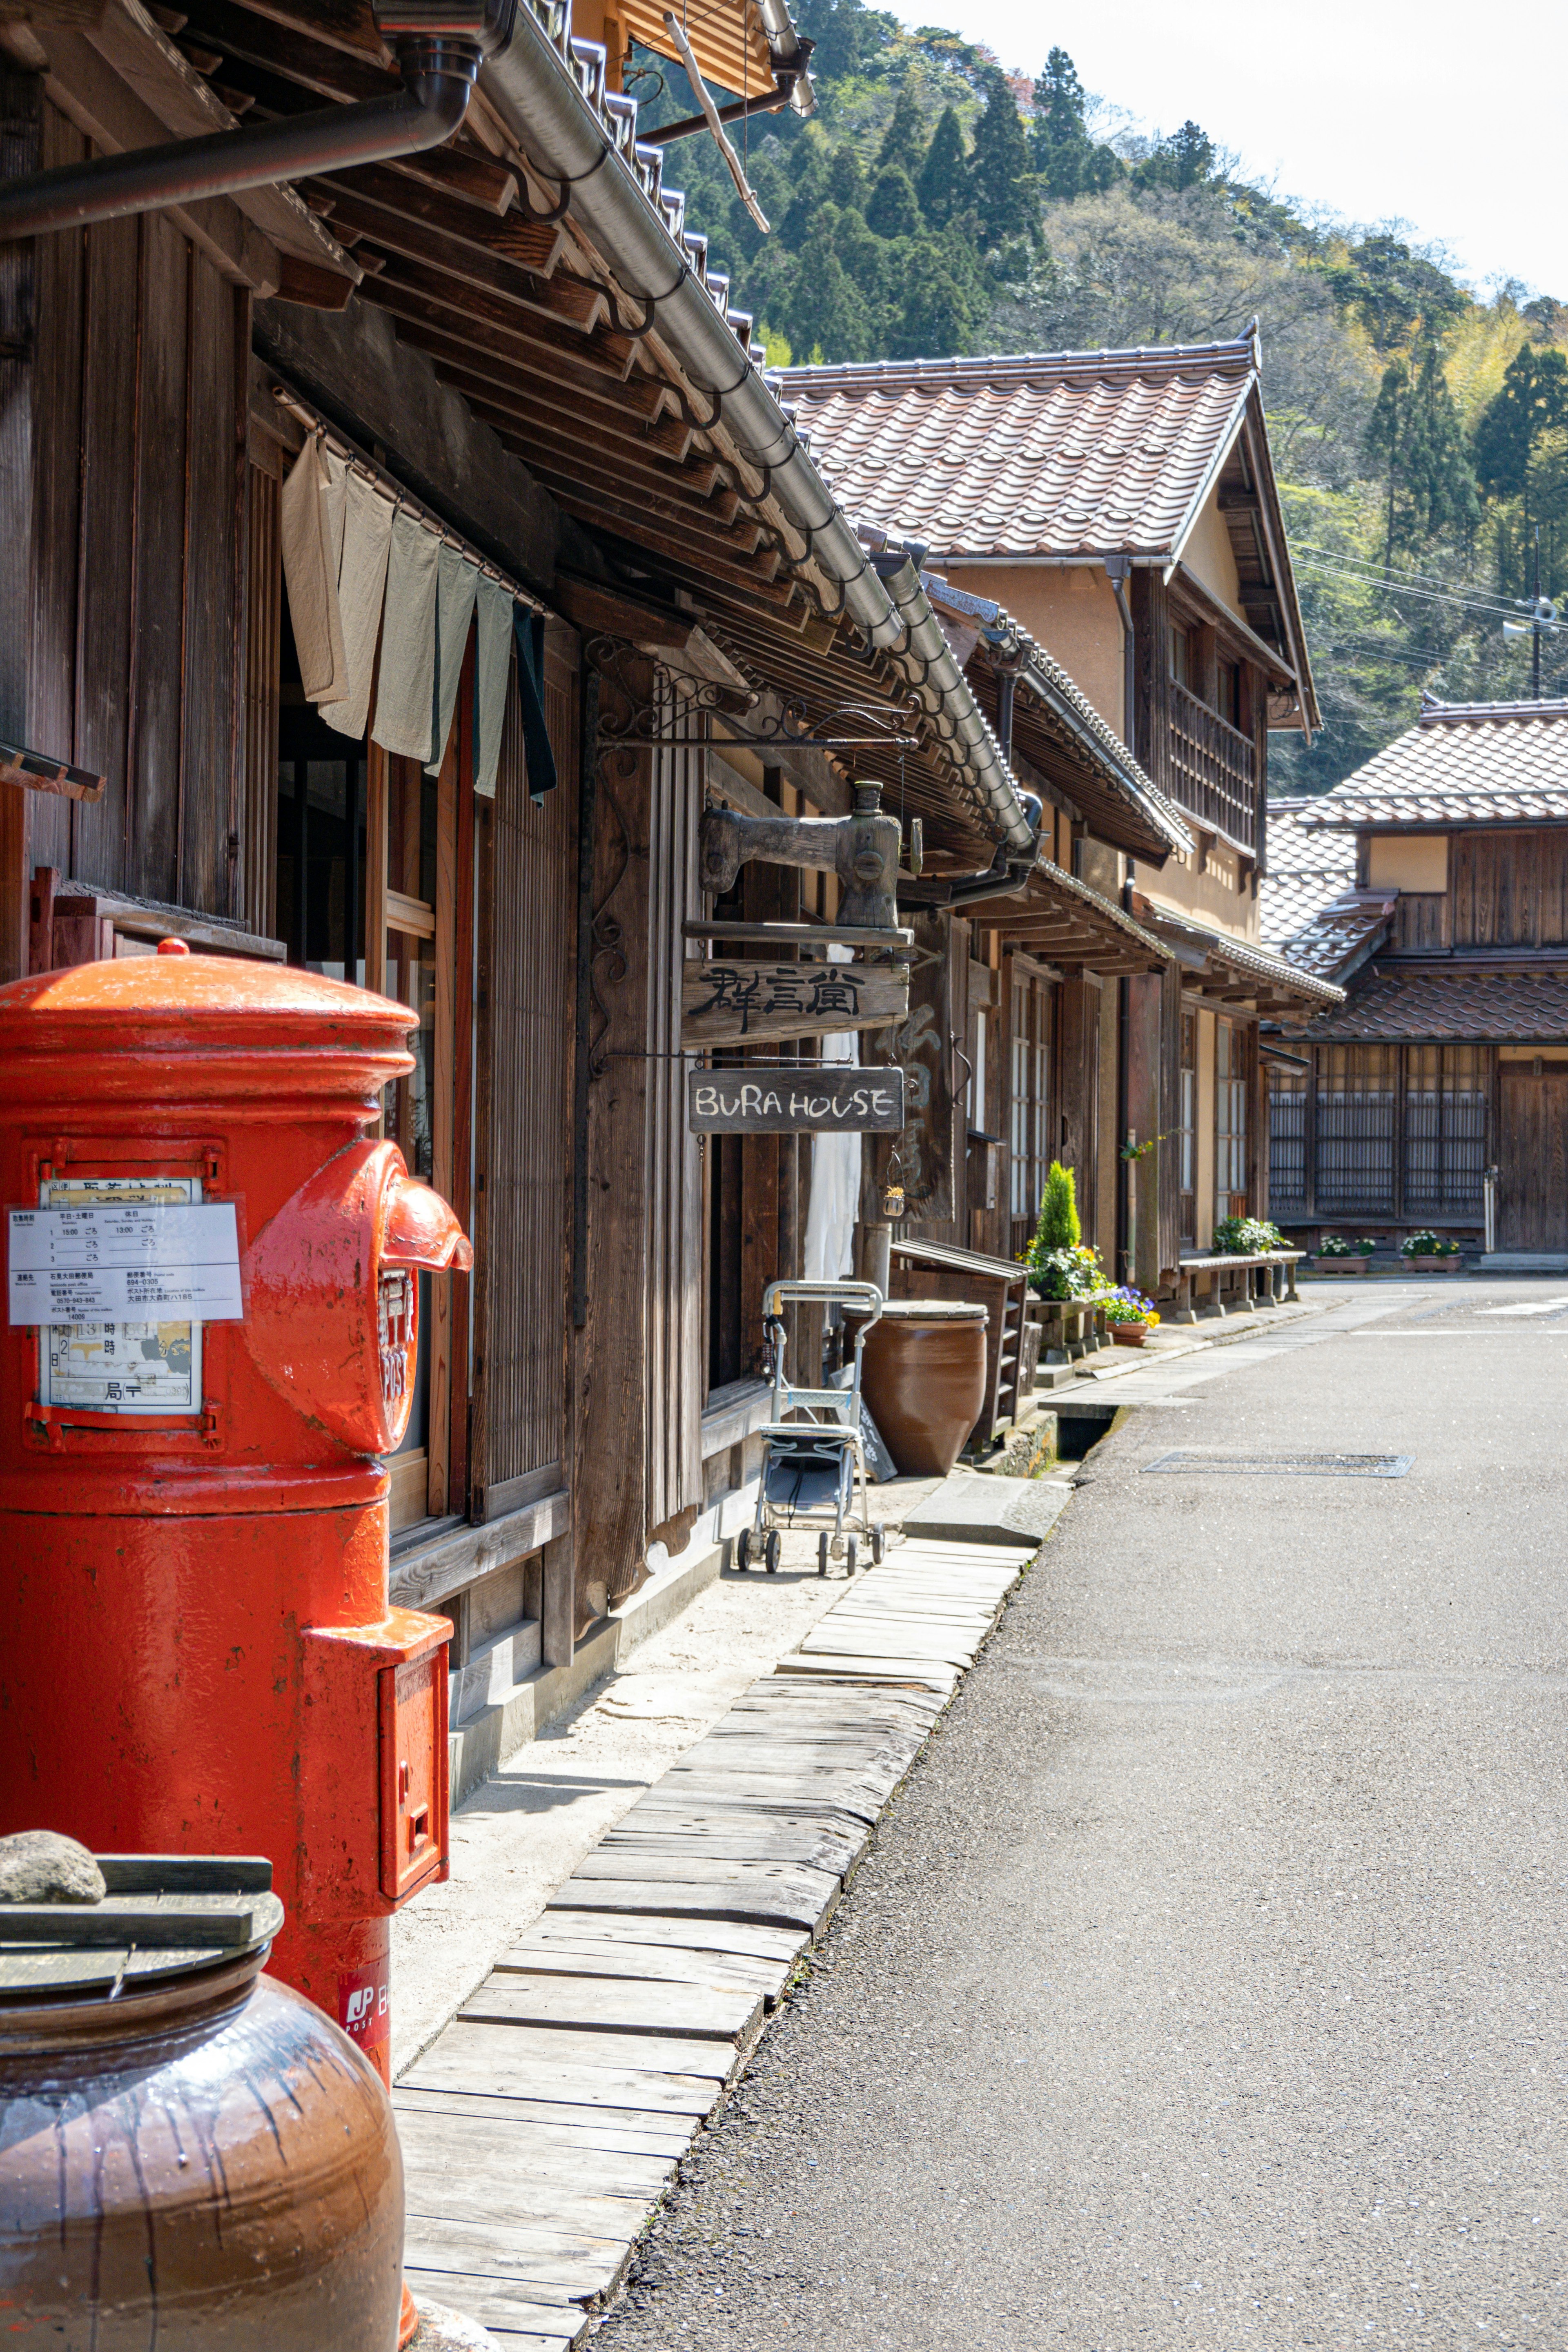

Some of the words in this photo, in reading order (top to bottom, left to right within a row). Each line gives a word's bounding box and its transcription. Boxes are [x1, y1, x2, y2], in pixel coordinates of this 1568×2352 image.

[688, 967, 865, 1034] 群言堂
[789, 1089, 895, 1118] HOUSE
[50, 1272, 94, 1280] 石見大田郵便局
[60, 1340, 67, 1355] 2
[104, 1340, 115, 1355] 時
[346, 2017, 373, 2033] POST
